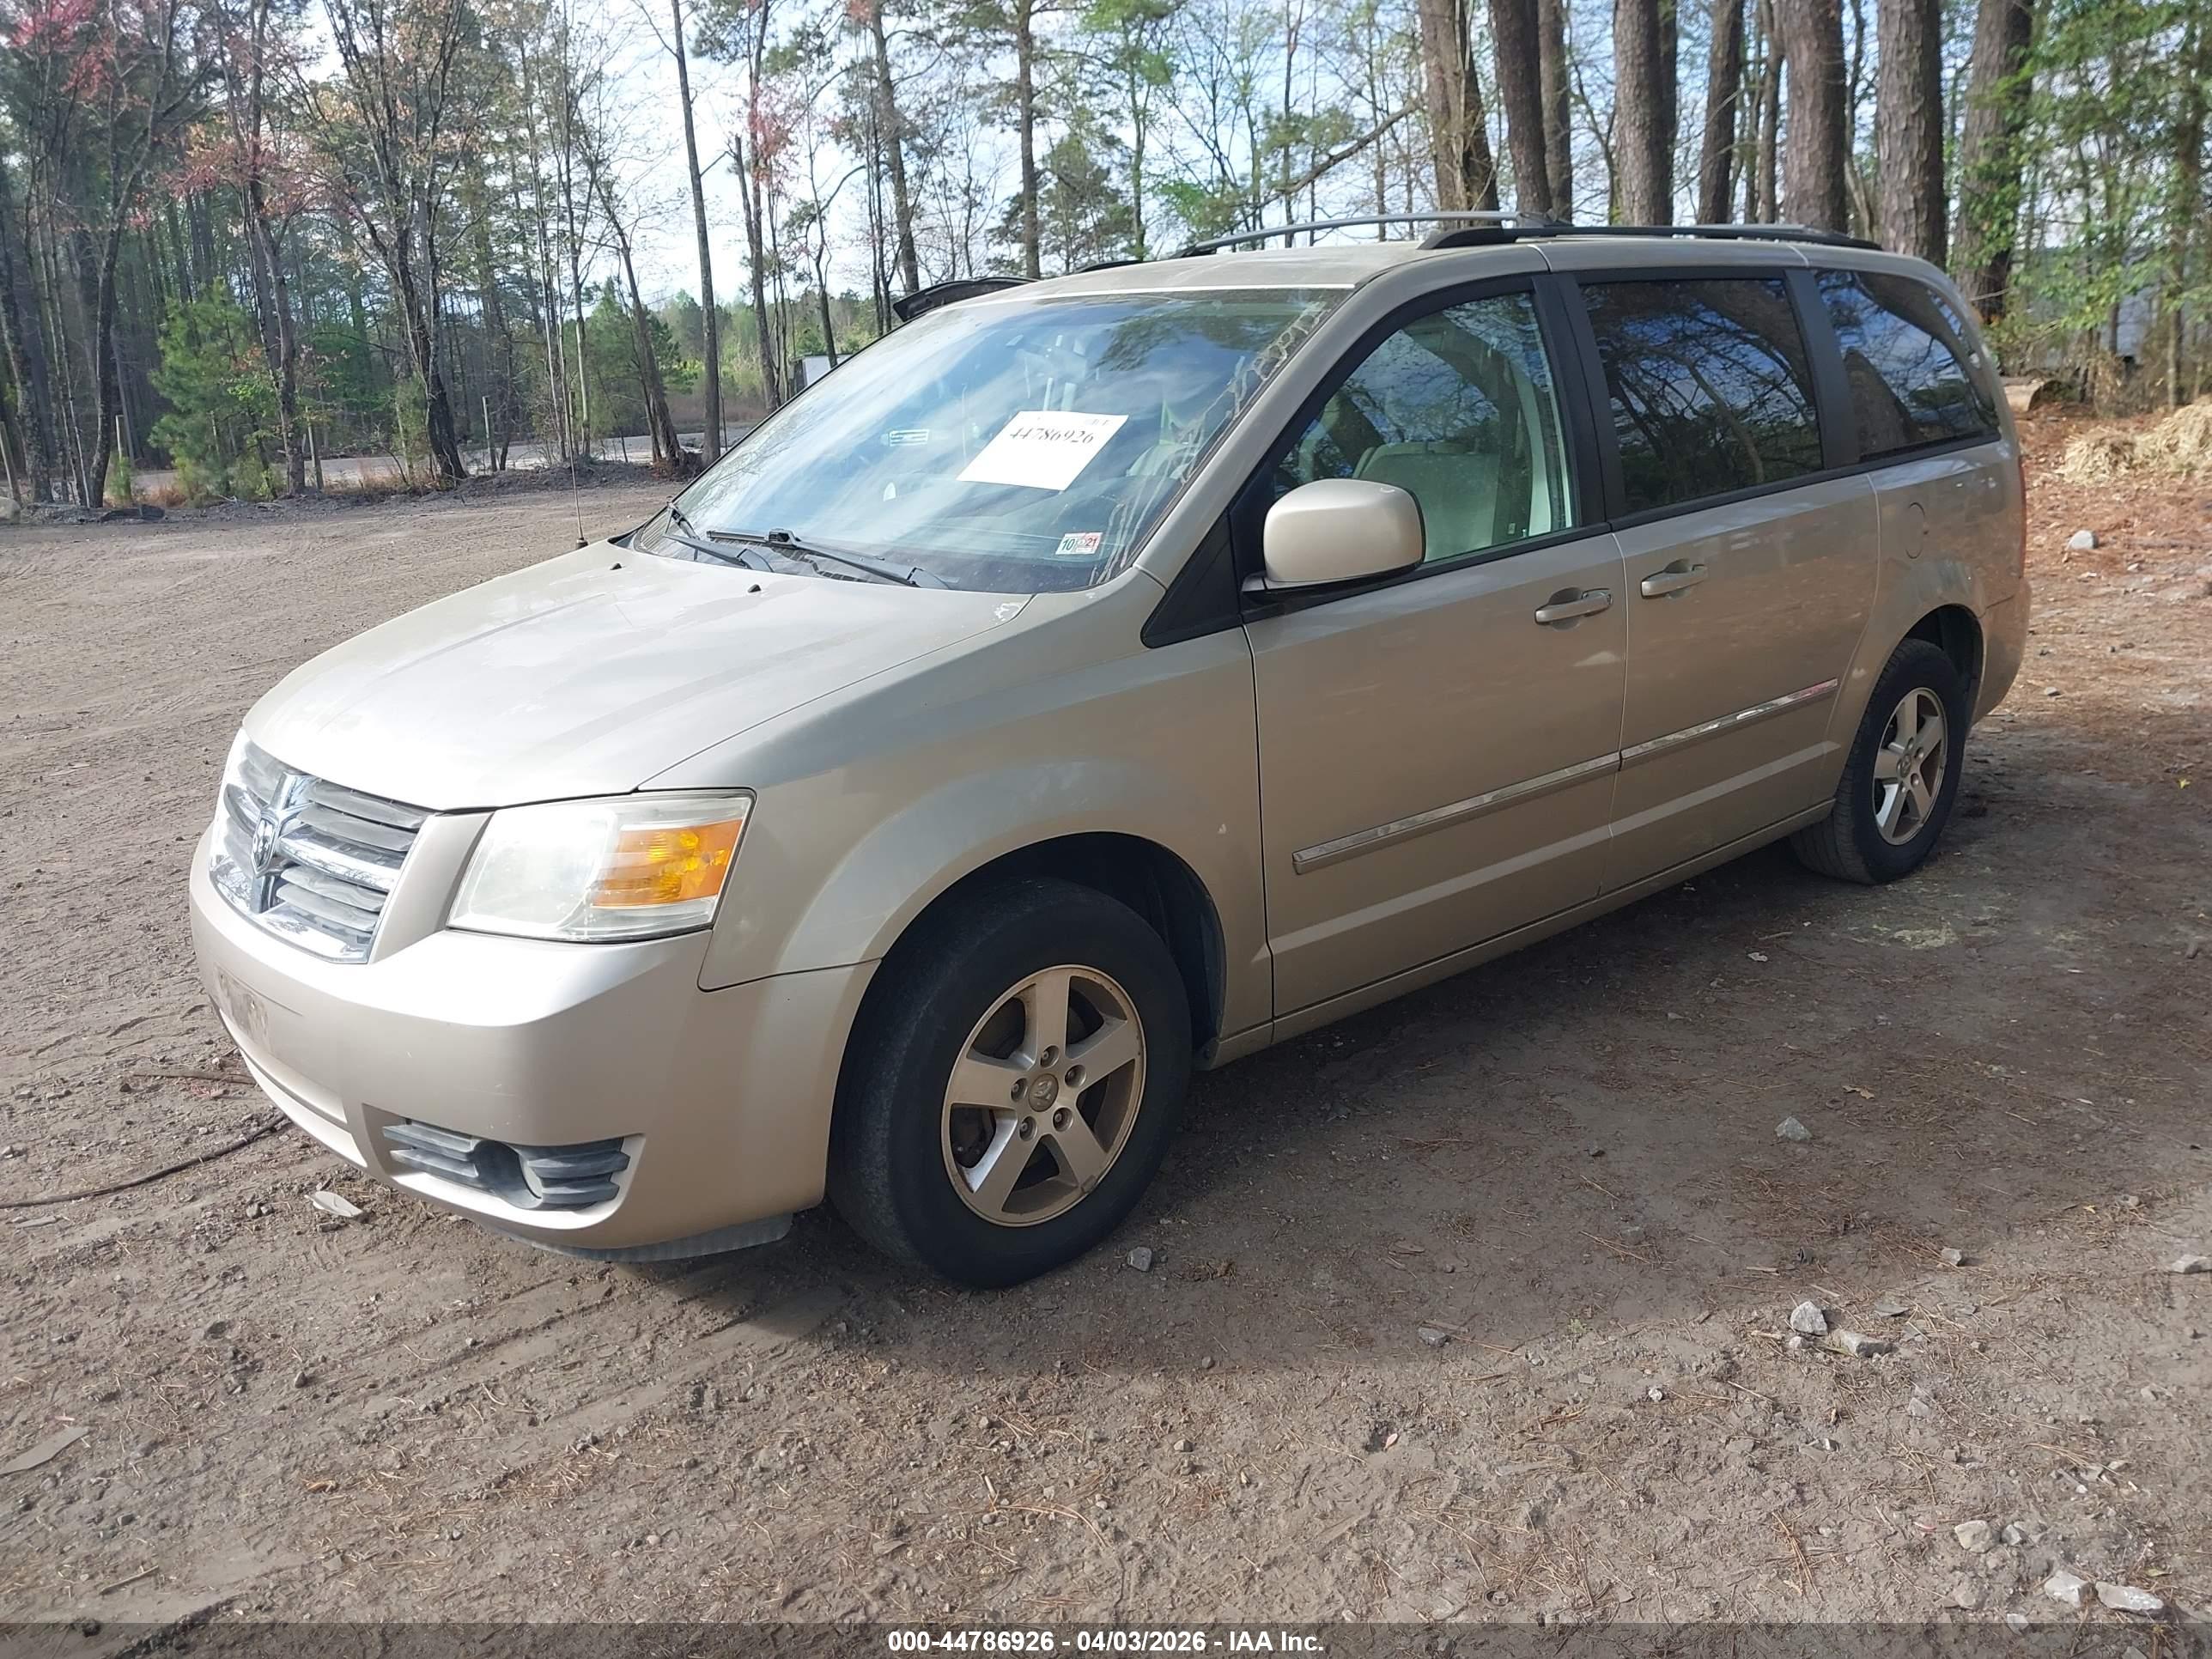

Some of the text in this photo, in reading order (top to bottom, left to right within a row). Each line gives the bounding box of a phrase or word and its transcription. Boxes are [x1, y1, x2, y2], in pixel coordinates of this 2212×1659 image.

[1010, 427, 1095, 444] 44786926
[1061, 538, 1076, 550] 10
[1085, 537, 1097, 547] 21
